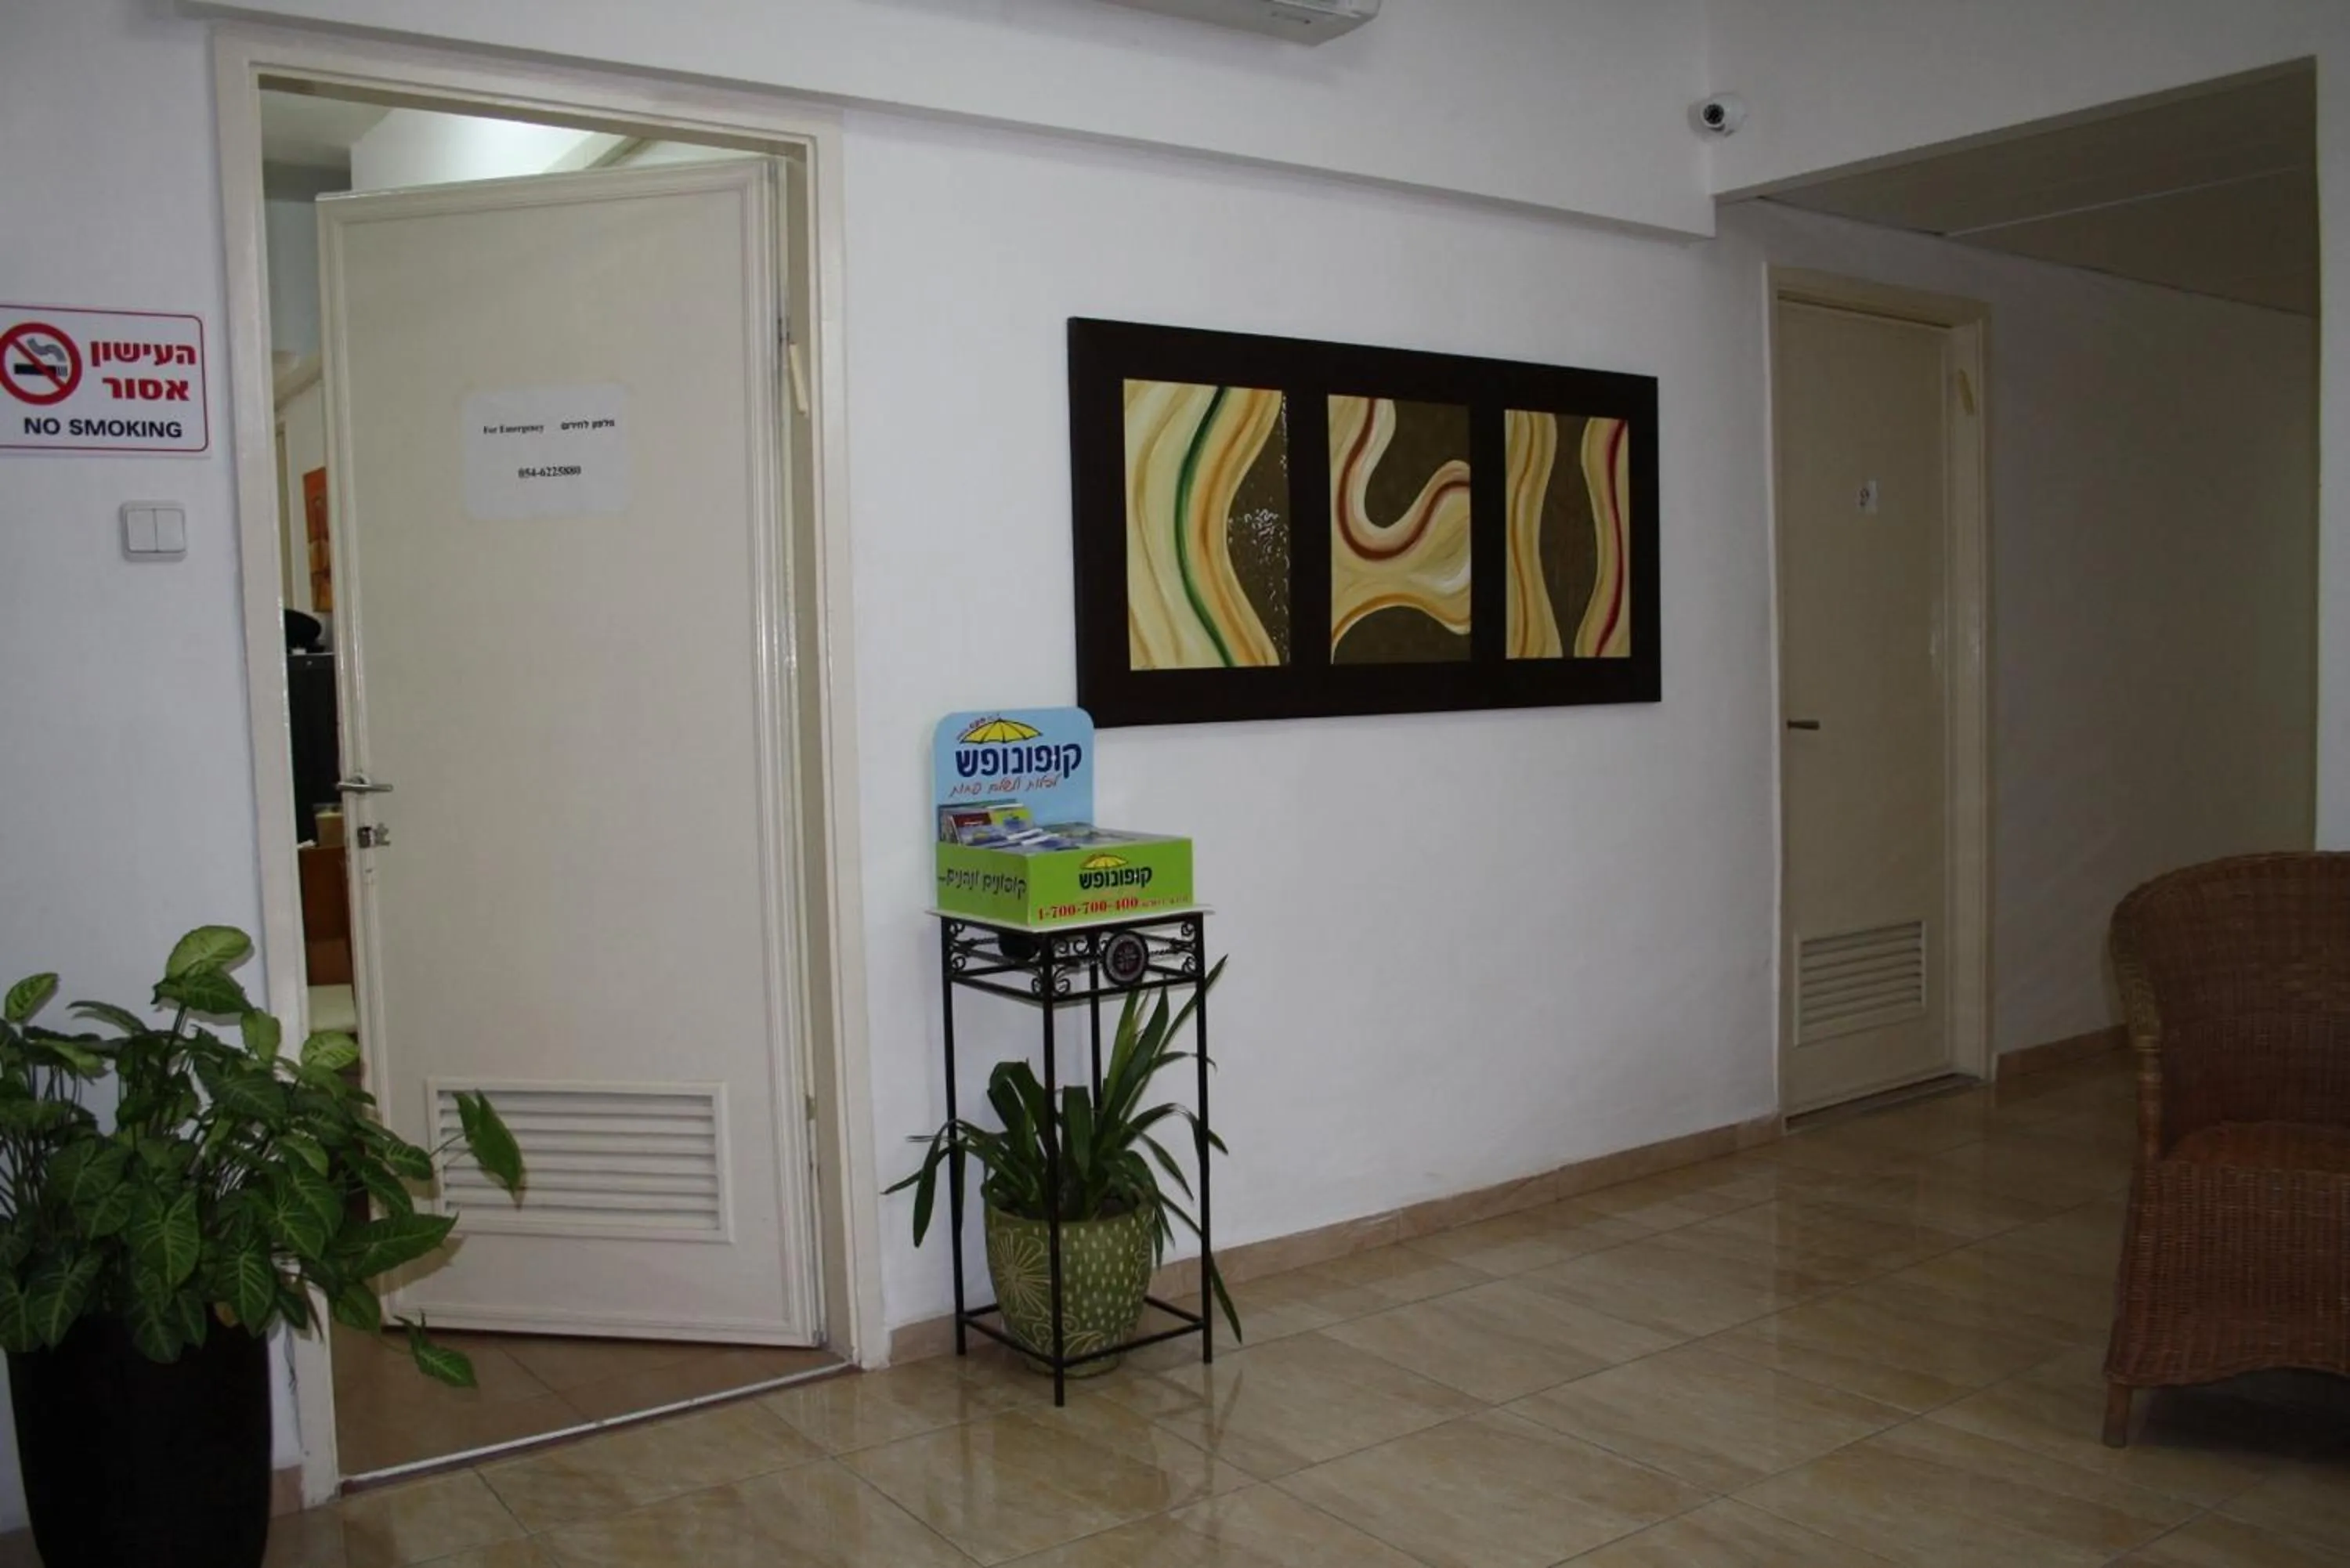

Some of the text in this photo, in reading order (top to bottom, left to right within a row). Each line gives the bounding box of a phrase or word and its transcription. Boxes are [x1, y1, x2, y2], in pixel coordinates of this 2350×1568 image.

[90, 341, 197, 367] העישון
[102, 377, 190, 401] אסור
[24, 417, 183, 438] NO SMOKING
[499, 425, 544, 435] Emergency
[955, 743, 1082, 779] קופונופש
[1079, 866, 1152, 890] קופונופש
